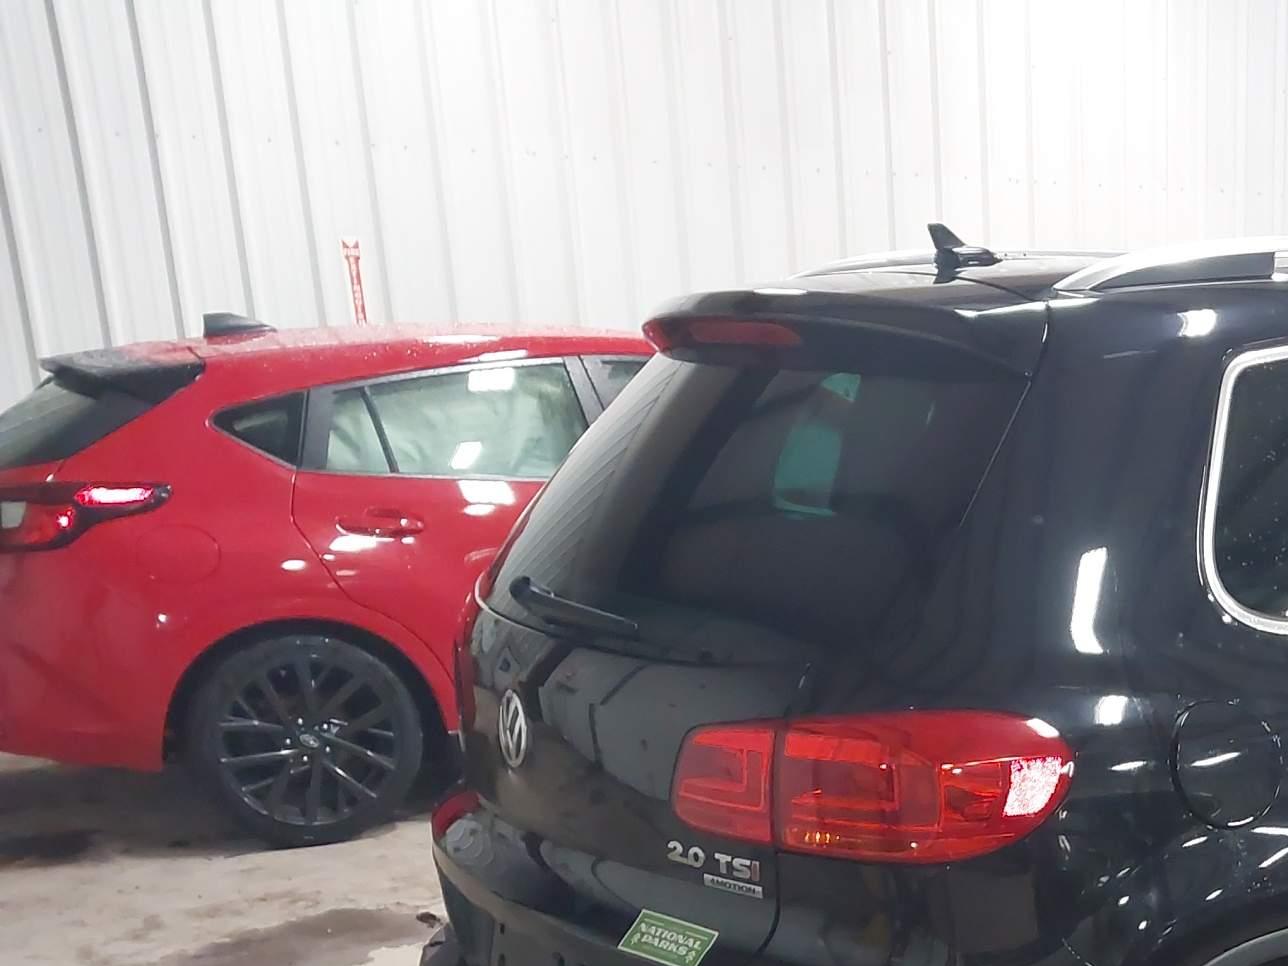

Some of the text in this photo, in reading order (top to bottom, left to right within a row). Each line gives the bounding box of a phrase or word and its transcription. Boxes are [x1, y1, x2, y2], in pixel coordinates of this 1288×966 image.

[714, 851, 760, 882] TSI
[640, 922, 702, 950] NATIONAL
[641, 933, 689, 956] PARKS
